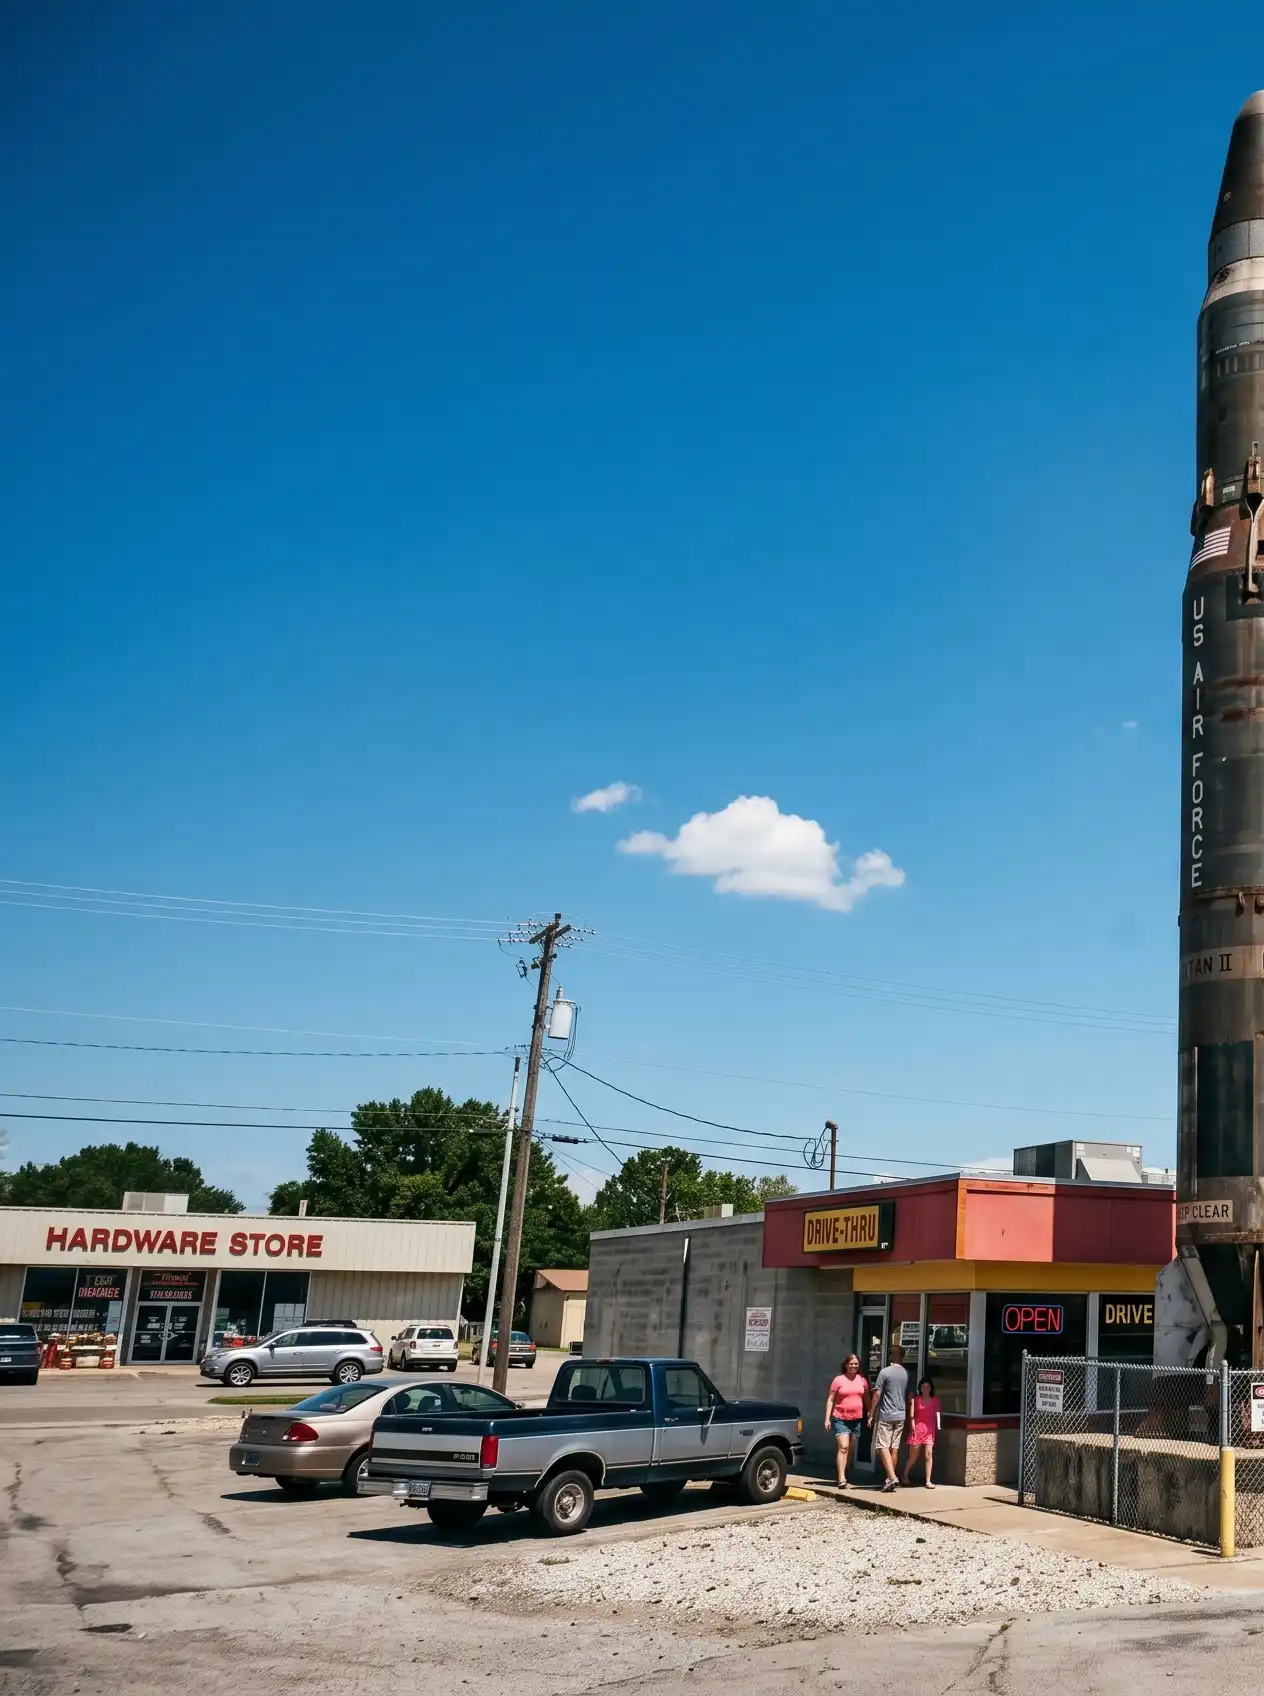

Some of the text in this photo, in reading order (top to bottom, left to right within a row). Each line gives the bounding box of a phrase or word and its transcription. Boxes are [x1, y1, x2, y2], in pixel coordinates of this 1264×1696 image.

[1191, 596, 1204, 888] US AIR FORCE
[1192, 1203, 1230, 1219] CLEAR
[45, 1226, 324, 1258] HARDWARE STORE
[806, 1213, 876, 1246] DRIVE-THRU
[1005, 1306, 1061, 1332] OPEN
[1105, 1303, 1153, 1325] DRIVE
